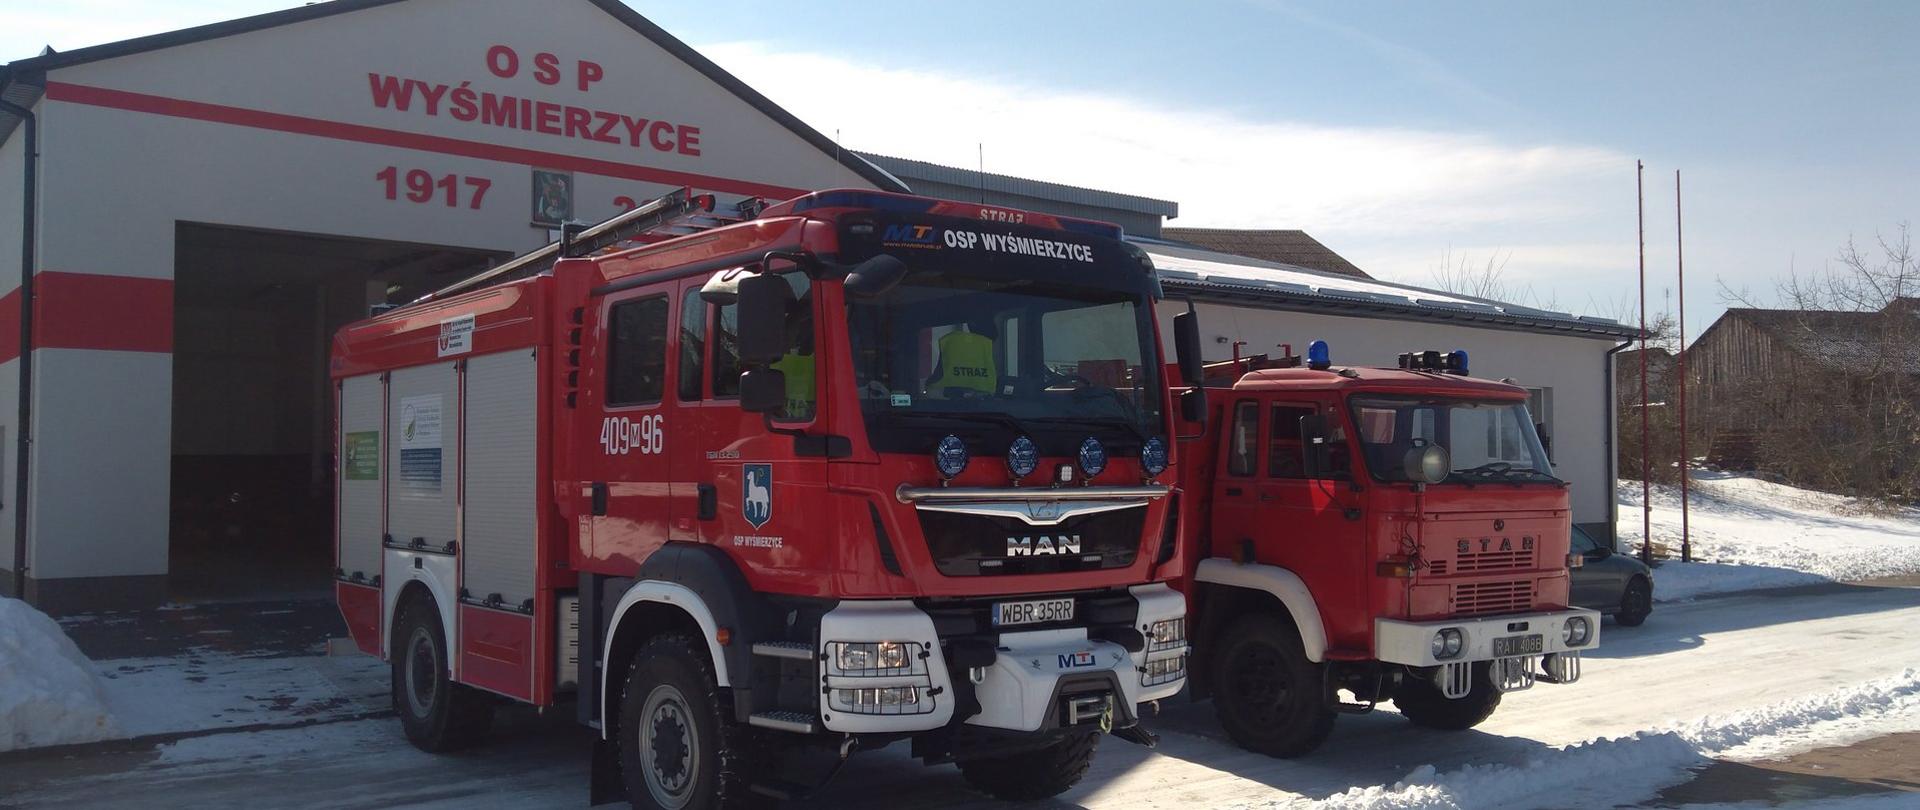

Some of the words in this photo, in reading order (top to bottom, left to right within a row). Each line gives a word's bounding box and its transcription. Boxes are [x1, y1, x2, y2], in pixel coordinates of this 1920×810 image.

[368, 73, 700, 156] WYŚMIERZYCE
[376, 166, 491, 209] 1917
[944, 229, 977, 249] OSP
[981, 232, 1093, 262] WYŚMIERZYCE
[600, 416, 629, 454] 409
[641, 415, 663, 454] 96
[1007, 535, 1080, 556] MAN
[1457, 537, 1533, 553] STAR
[1002, 603, 1034, 623] WBR
[1038, 600, 1072, 620] 35RR
